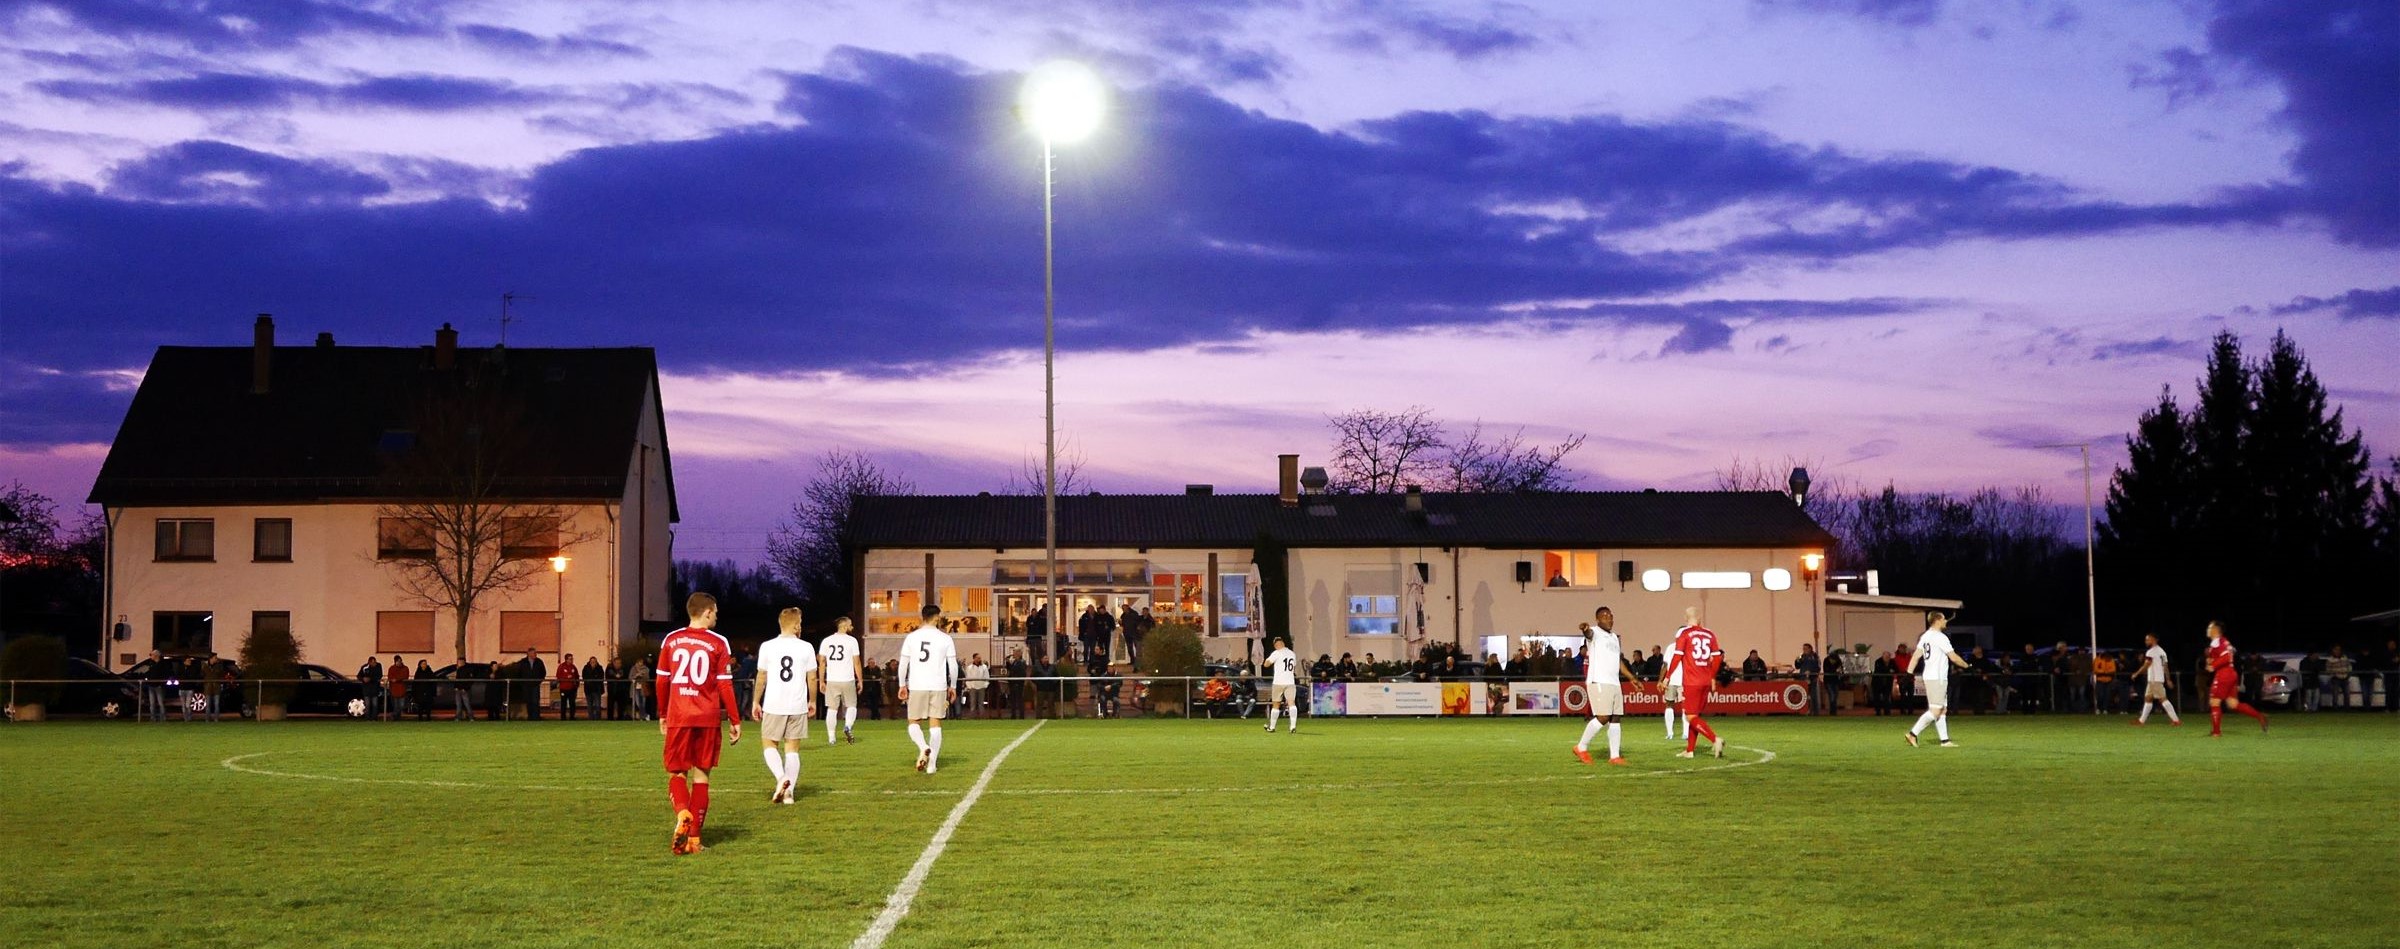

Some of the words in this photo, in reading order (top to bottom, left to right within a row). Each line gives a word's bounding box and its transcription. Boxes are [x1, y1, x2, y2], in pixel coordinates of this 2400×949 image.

[829, 644, 844, 660] 23
[919, 641, 930, 662] 5
[1692, 637, 1710, 660] 35
[672, 648, 709, 685] 20
[780, 655, 793, 682] 8
[1283, 657, 1293, 671] 16
[1623, 691, 1658, 703] rüßen
[1707, 690, 1779, 703] Mannschaft
